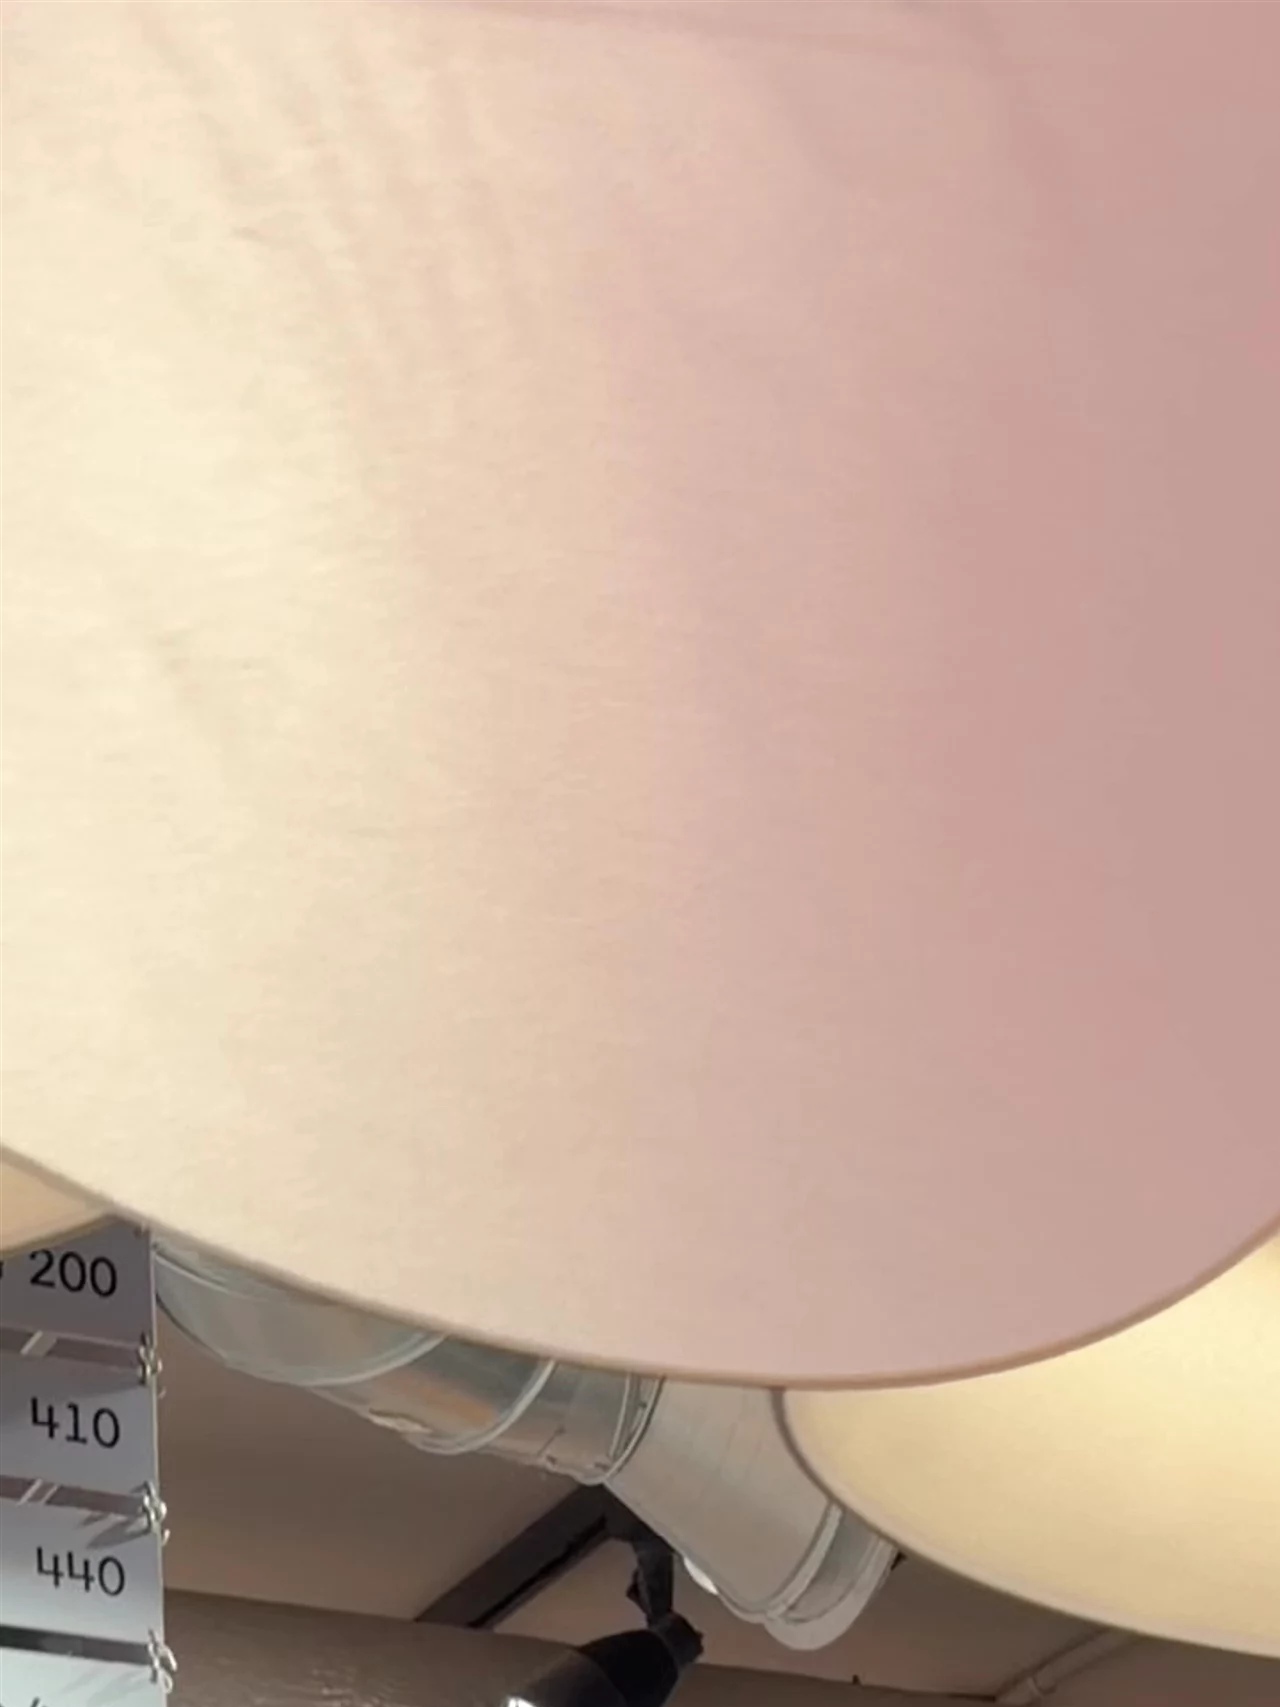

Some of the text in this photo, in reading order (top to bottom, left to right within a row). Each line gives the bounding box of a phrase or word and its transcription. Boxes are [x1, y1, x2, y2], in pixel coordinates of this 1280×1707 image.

[29, 1249, 117, 1297] 200
[30, 1397, 120, 1448] 410
[36, 1546, 125, 1596] 440
